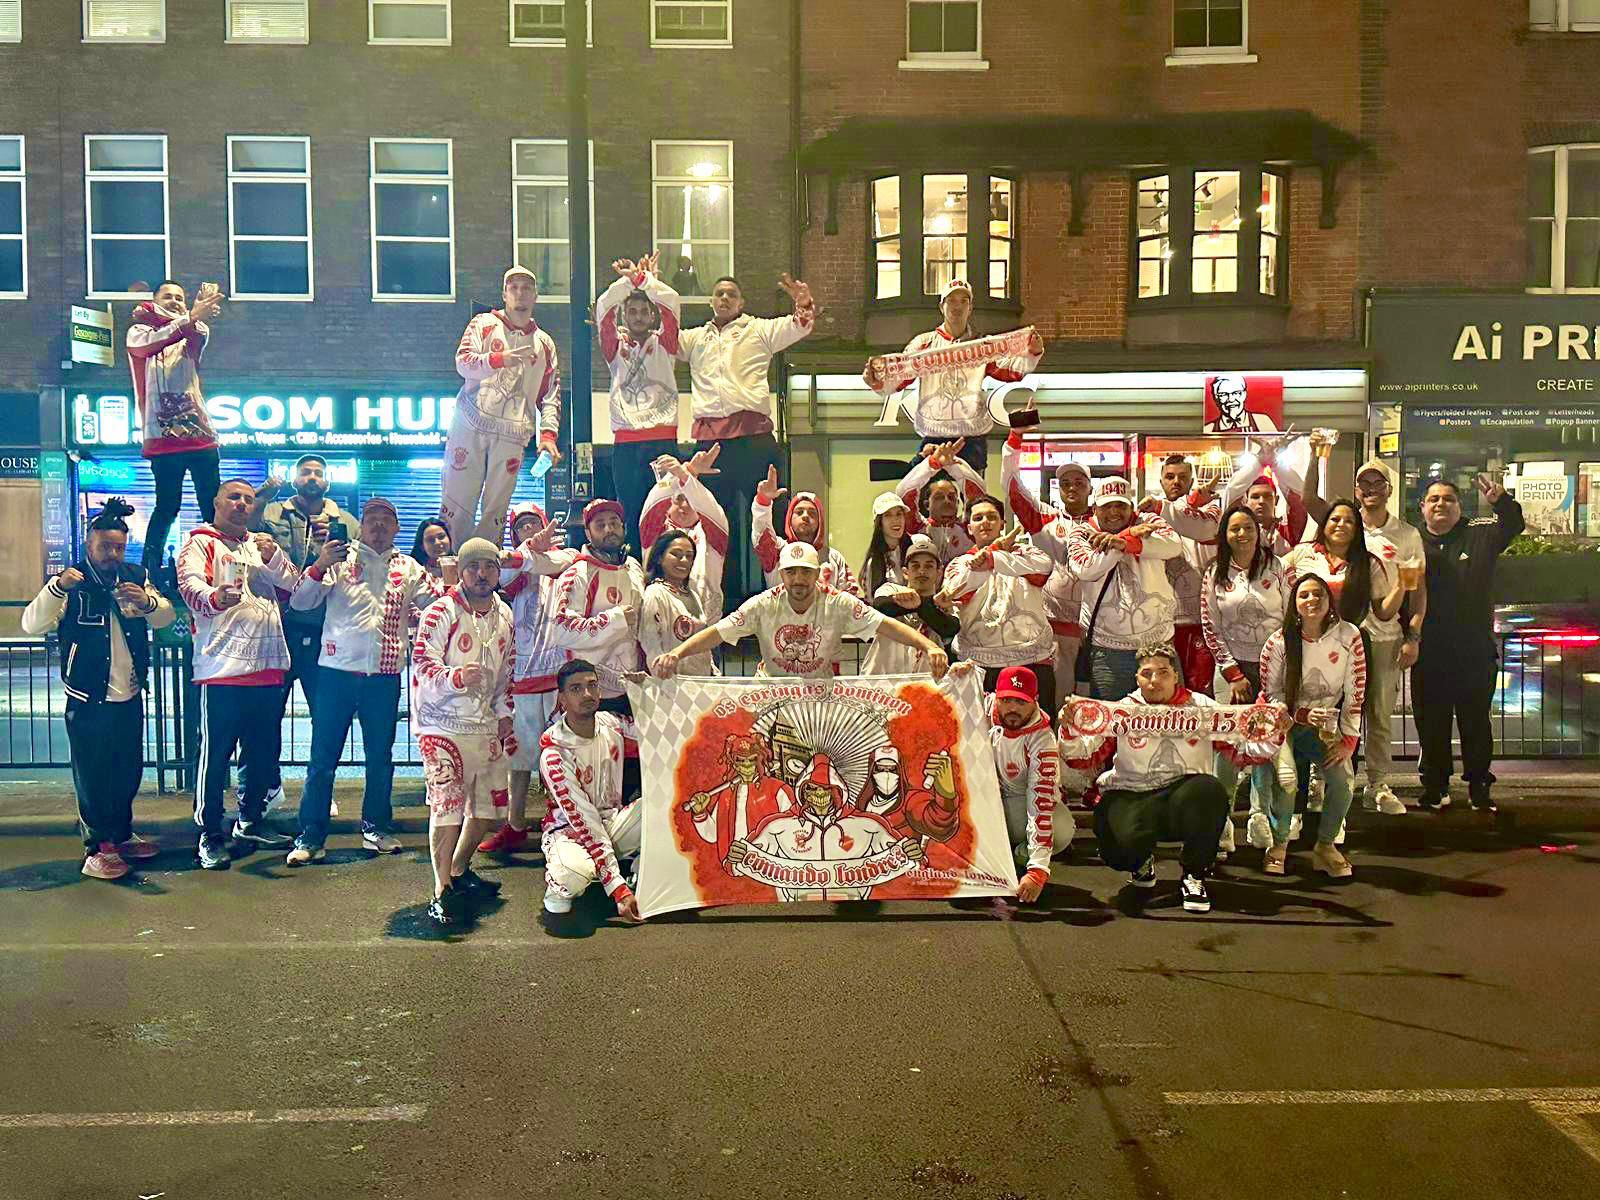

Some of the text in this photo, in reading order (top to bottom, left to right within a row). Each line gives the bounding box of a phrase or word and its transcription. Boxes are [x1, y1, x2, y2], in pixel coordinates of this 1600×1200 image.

[1452, 322, 1502, 360] Ai
[1379, 383, 1479, 392] www.aiprinters.co.uk
[1537, 379, 1594, 391] CREATE
[873, 382, 1040, 427] KC
[1446, 418, 1471, 426] Posters
[1486, 418, 1534, 426] Encapsulation
[1552, 418, 1574, 426] Popup
[1102, 482, 1126, 495] 1943
[1522, 482, 1562, 491] PHOTO
[1522, 491, 1565, 500] PRINT
[741, 846, 909, 887] comando londres
